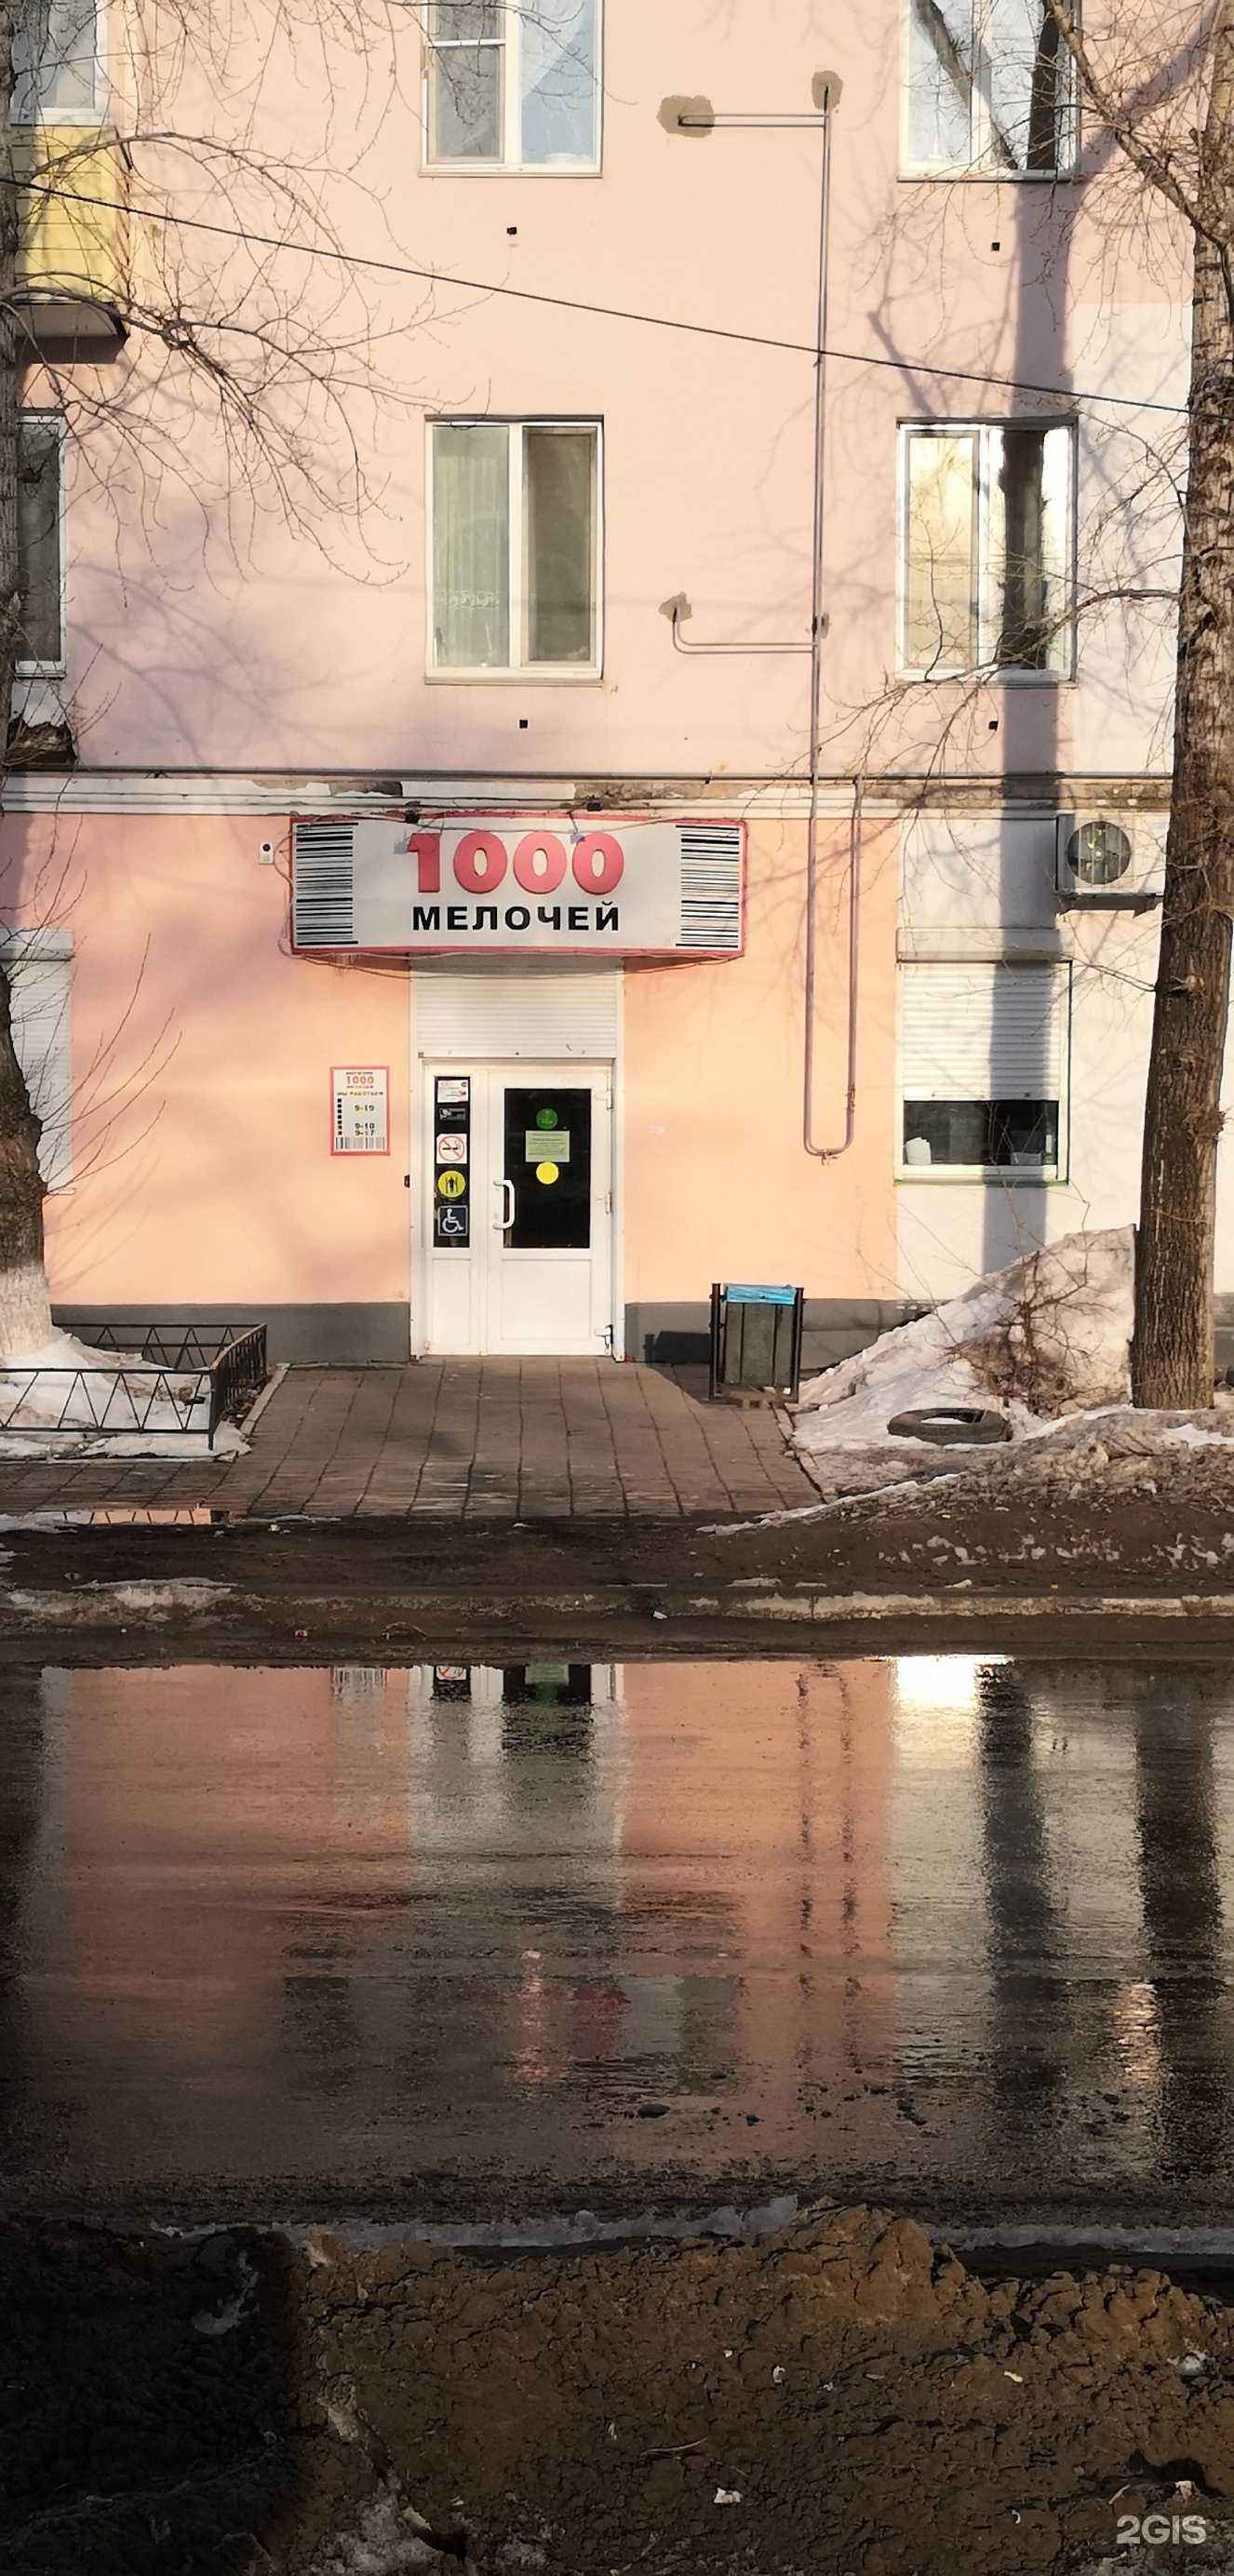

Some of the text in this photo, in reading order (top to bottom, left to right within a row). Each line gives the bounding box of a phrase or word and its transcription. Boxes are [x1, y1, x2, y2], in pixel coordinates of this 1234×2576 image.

[407, 829, 624, 895] 1000
[412, 901, 619, 931] МЕЛОЧЕЙ
[346, 1075, 374, 1085] 1000
